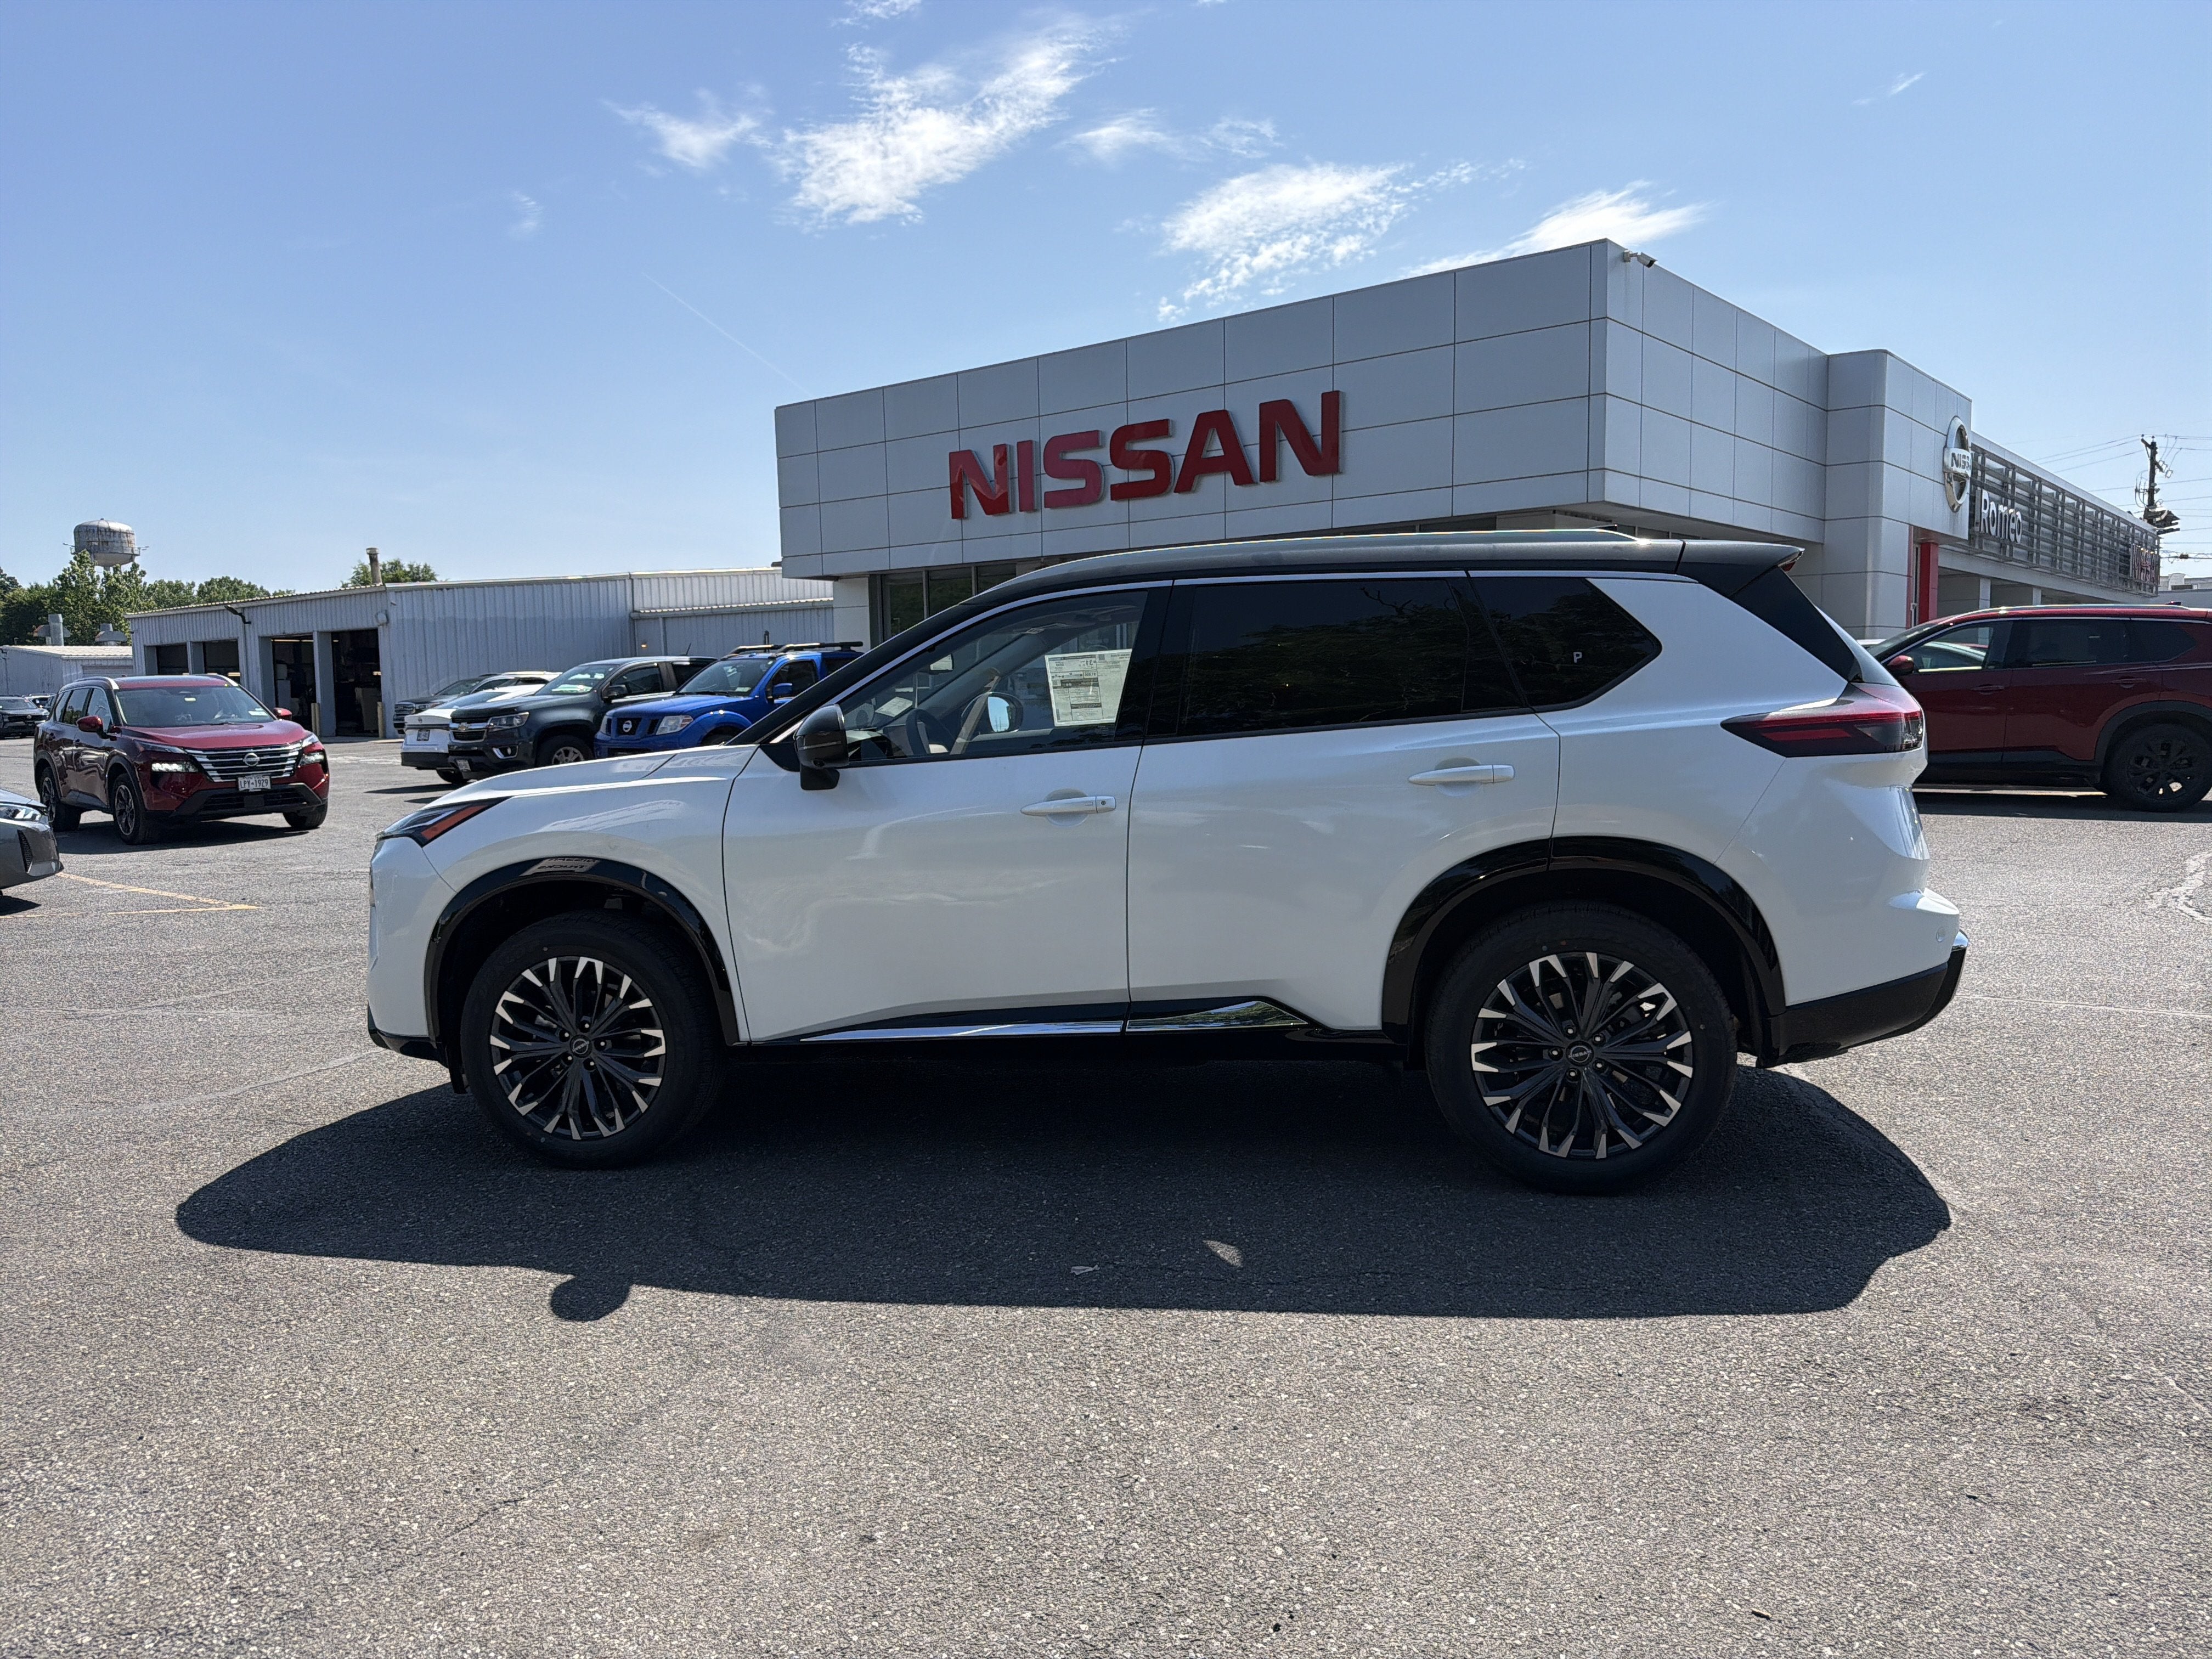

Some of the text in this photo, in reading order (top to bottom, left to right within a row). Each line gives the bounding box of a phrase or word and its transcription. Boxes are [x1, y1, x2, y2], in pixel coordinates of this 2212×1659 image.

[949, 390, 1342, 520] NISSAN
[1951, 452, 1971, 470] NISS
[1980, 489, 2022, 544] Romeo
[1573, 651, 1582, 663] P
